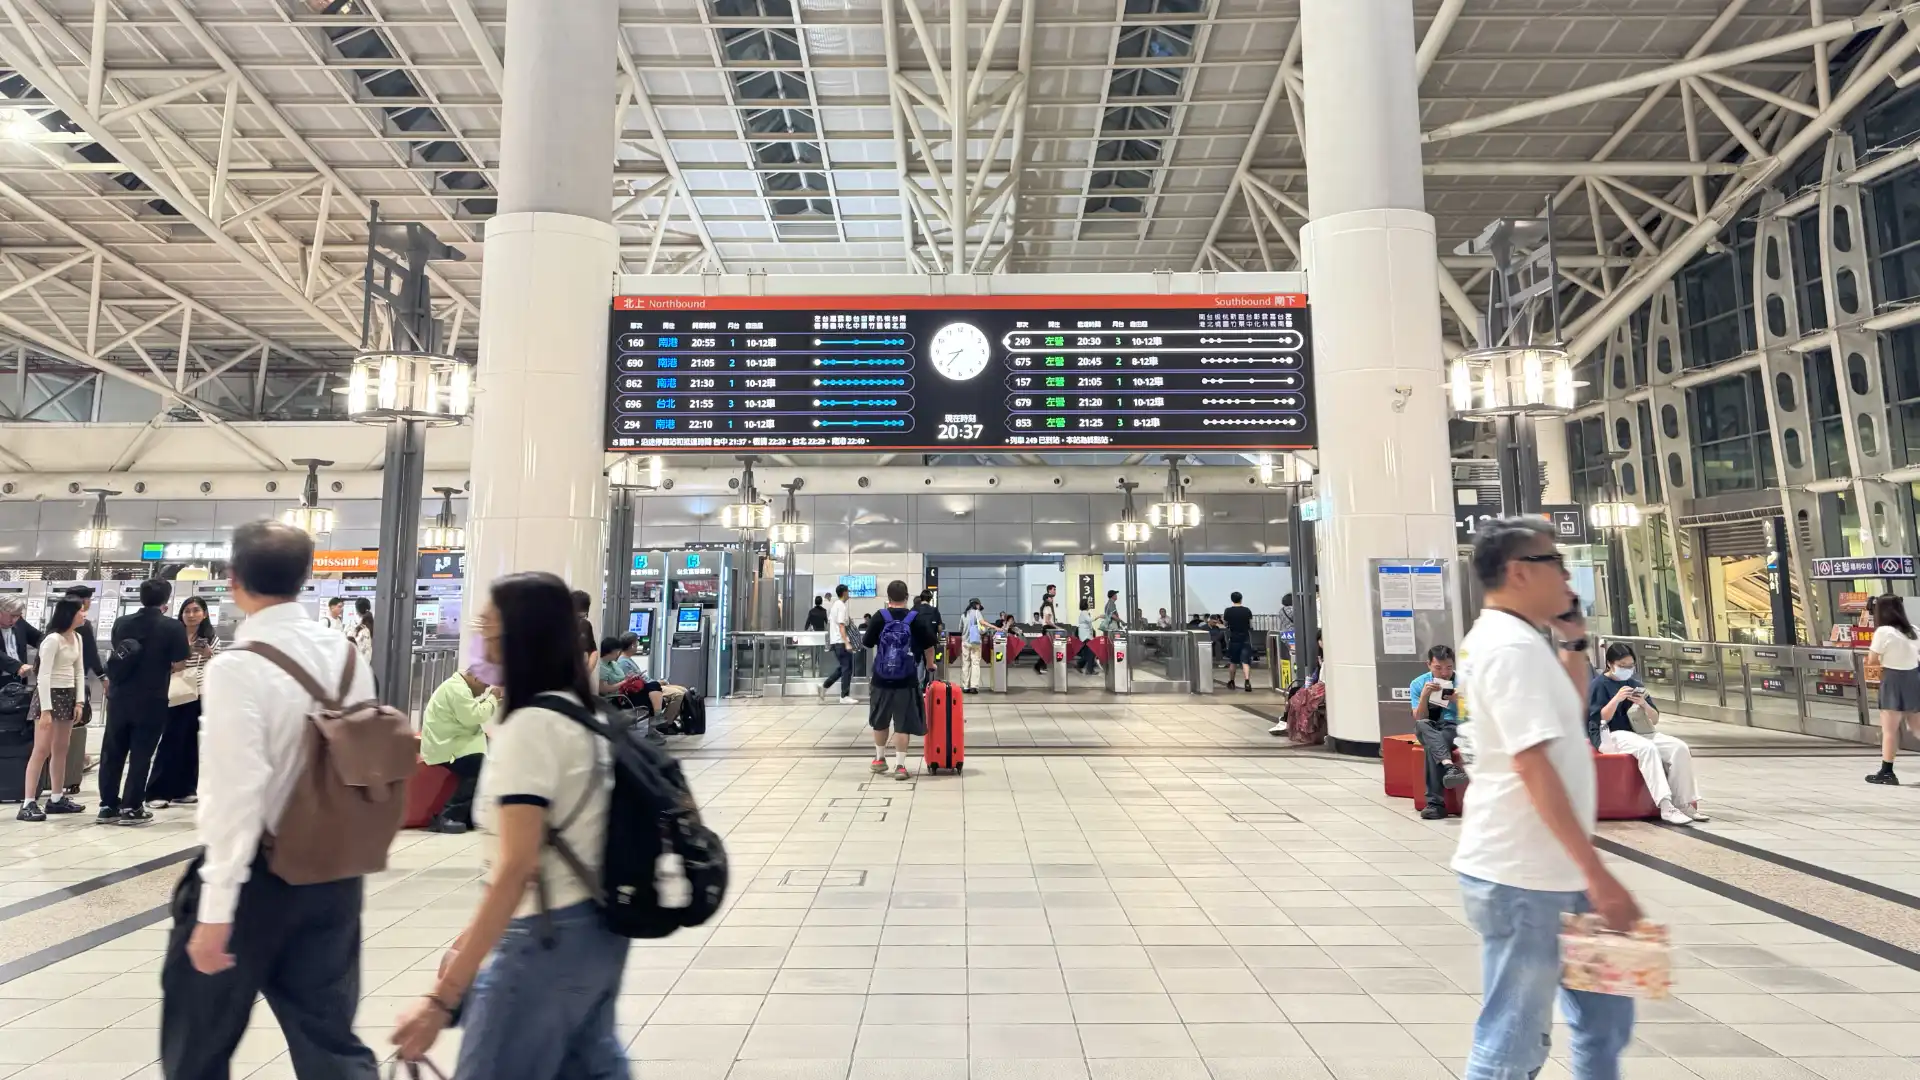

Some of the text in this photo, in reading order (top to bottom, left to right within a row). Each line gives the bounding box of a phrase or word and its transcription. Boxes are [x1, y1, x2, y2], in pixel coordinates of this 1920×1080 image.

[624, 298, 706, 309] 北上 Northbound
[1214, 297, 1271, 306] Southbound
[628, 338, 644, 348] 160
[658, 338, 678, 348] 南港
[691, 338, 716, 348] 20:55
[730, 338, 735, 348] 1
[1014, 337, 1030, 346] 249
[1044, 337, 1064, 346] 左營
[1077, 337, 1102, 346] 20:30
[1115, 337, 1121, 346] 3
[627, 358, 643, 368] 690
[658, 358, 678, 368] 南港
[690, 358, 715, 368] 21:05
[729, 358, 735, 368] 2
[1015, 357, 1031, 366] 675
[1046, 357, 1064, 366] 左營
[1077, 357, 1102, 366] 20:45
[1116, 357, 1122, 366] 2
[626, 378, 642, 388] 862
[657, 378, 677, 388] 南港
[690, 378, 714, 388] 21:30
[729, 378, 734, 388] 1
[1015, 377, 1031, 387] 157
[1046, 377, 1064, 387] 左營
[1078, 377, 1102, 387] 21:05
[1117, 377, 1121, 387] 1
[625, 399, 642, 409] 696
[656, 399, 676, 409] 台北
[689, 399, 713, 409] 21:55
[728, 399, 734, 409] 3
[1015, 397, 1031, 407] 679
[1046, 397, 1065, 407] 左營
[1079, 397, 1102, 407] 21:20
[1117, 397, 1122, 407] 1
[624, 420, 640, 429] 294
[655, 420, 675, 429] 南港
[688, 420, 713, 429] 22:10
[728, 420, 733, 429] 1
[1016, 418, 1032, 427] 853
[1046, 418, 1065, 427] 左營
[1079, 418, 1103, 427] 21:25
[1118, 418, 1123, 427] 3
[938, 424, 984, 439] 20:37
[1766, 536, 1772, 547] 2
[1084, 586, 1090, 594] 3
